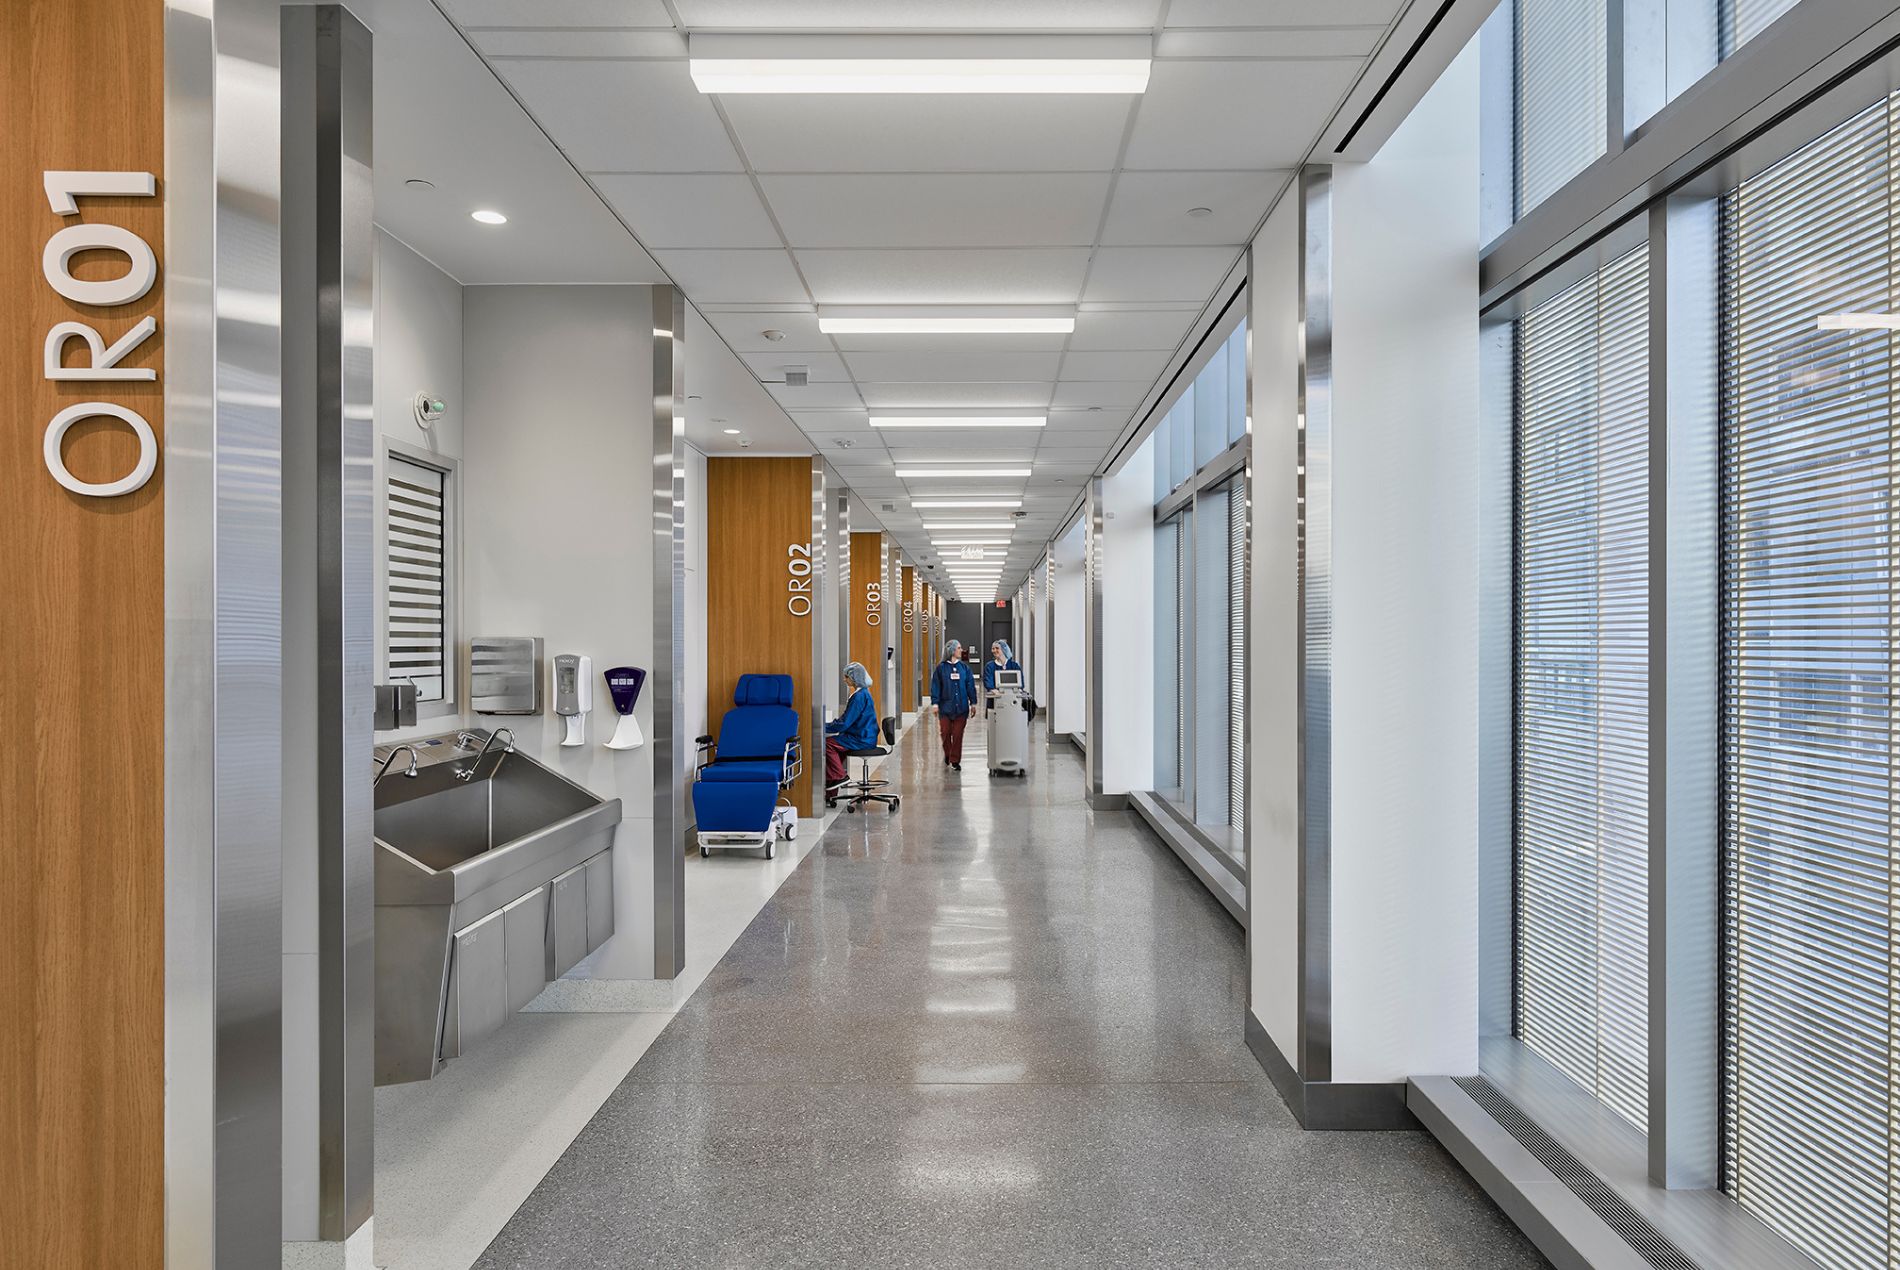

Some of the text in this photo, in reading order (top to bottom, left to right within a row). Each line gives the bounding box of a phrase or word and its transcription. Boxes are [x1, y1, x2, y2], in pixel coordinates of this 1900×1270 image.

[43, 170, 158, 498] OR01
[788, 543, 812, 616] OR02
[866, 582, 881, 626] OR03
[903, 601, 913, 633] OR04
